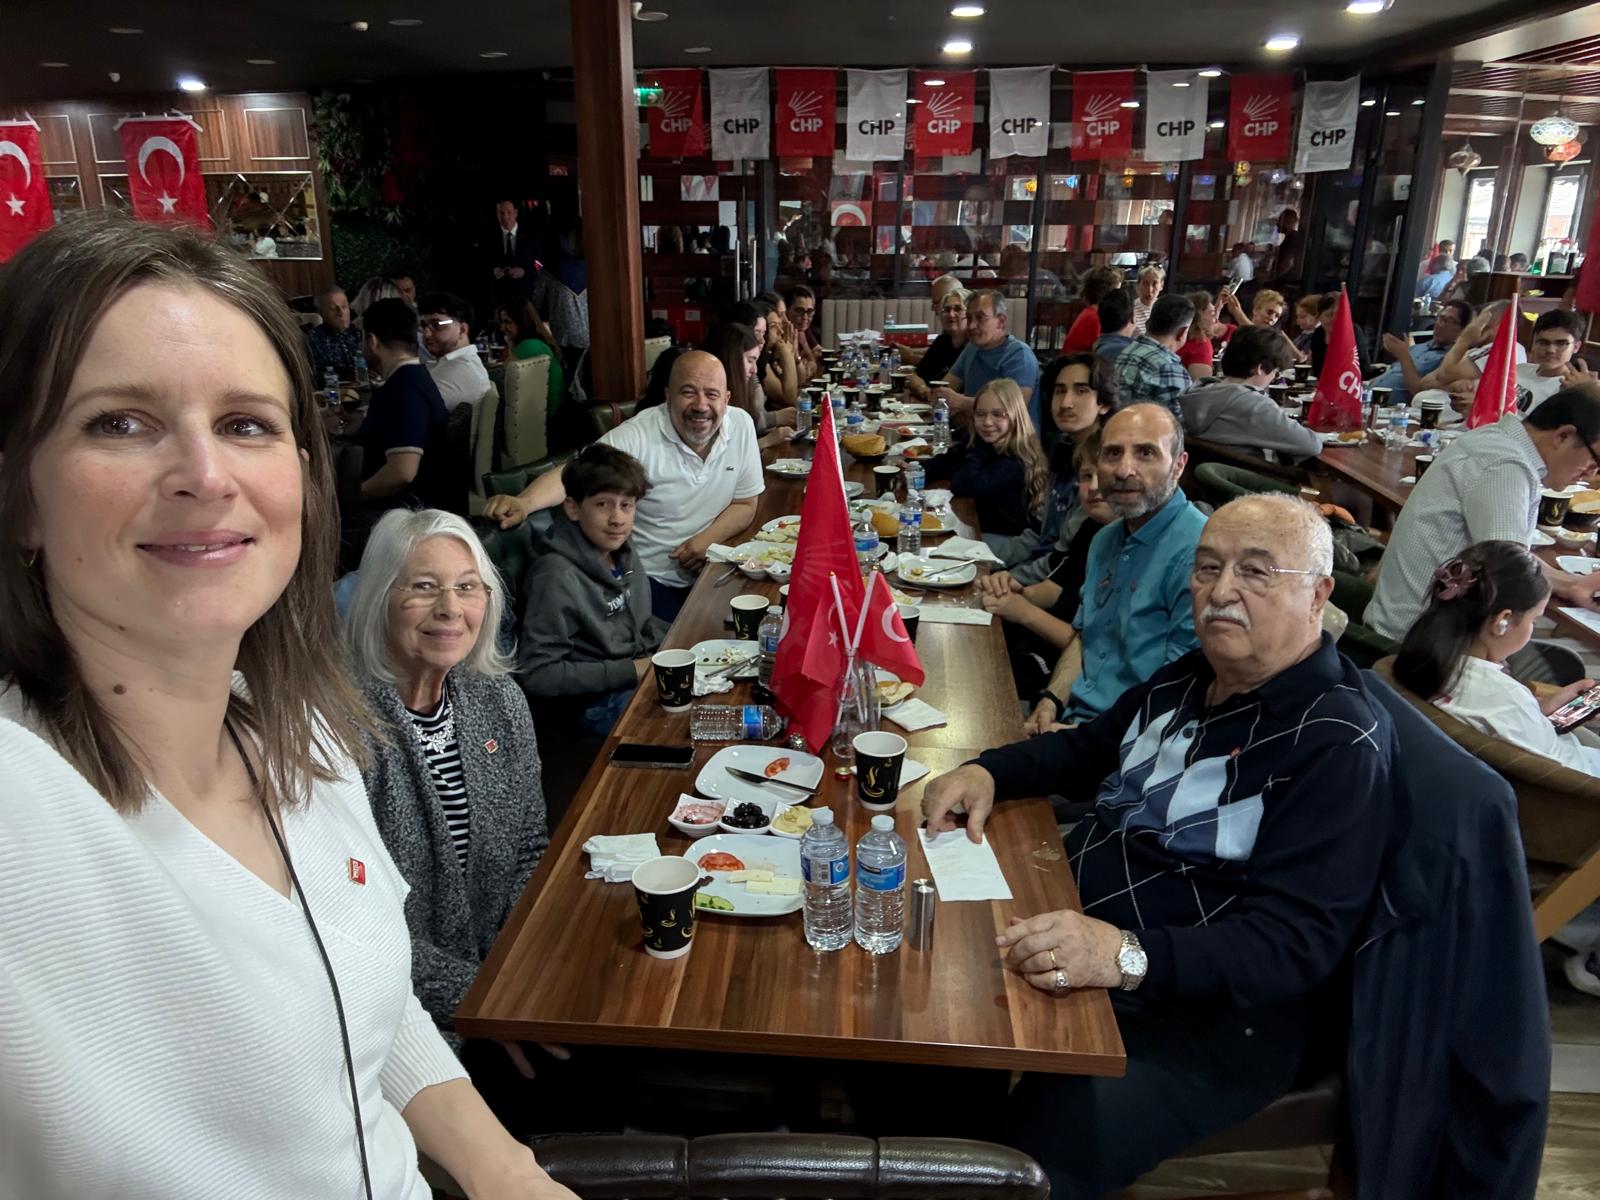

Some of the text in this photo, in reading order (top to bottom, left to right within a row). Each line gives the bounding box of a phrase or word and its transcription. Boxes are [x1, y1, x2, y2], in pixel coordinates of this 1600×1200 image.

[660, 118, 692, 133] CHP
[723, 118, 760, 134] CHP
[790, 118, 823, 132] CHP
[858, 119, 895, 135] CHP
[927, 120, 961, 134] CHP
[1001, 118, 1038, 134] CHP
[1086, 121, 1120, 136] CHP
[1157, 120, 1195, 137] CHP
[1243, 121, 1279, 137] CHP
[1311, 128, 1346, 147] CHP
[1338, 370, 1362, 402] CH
